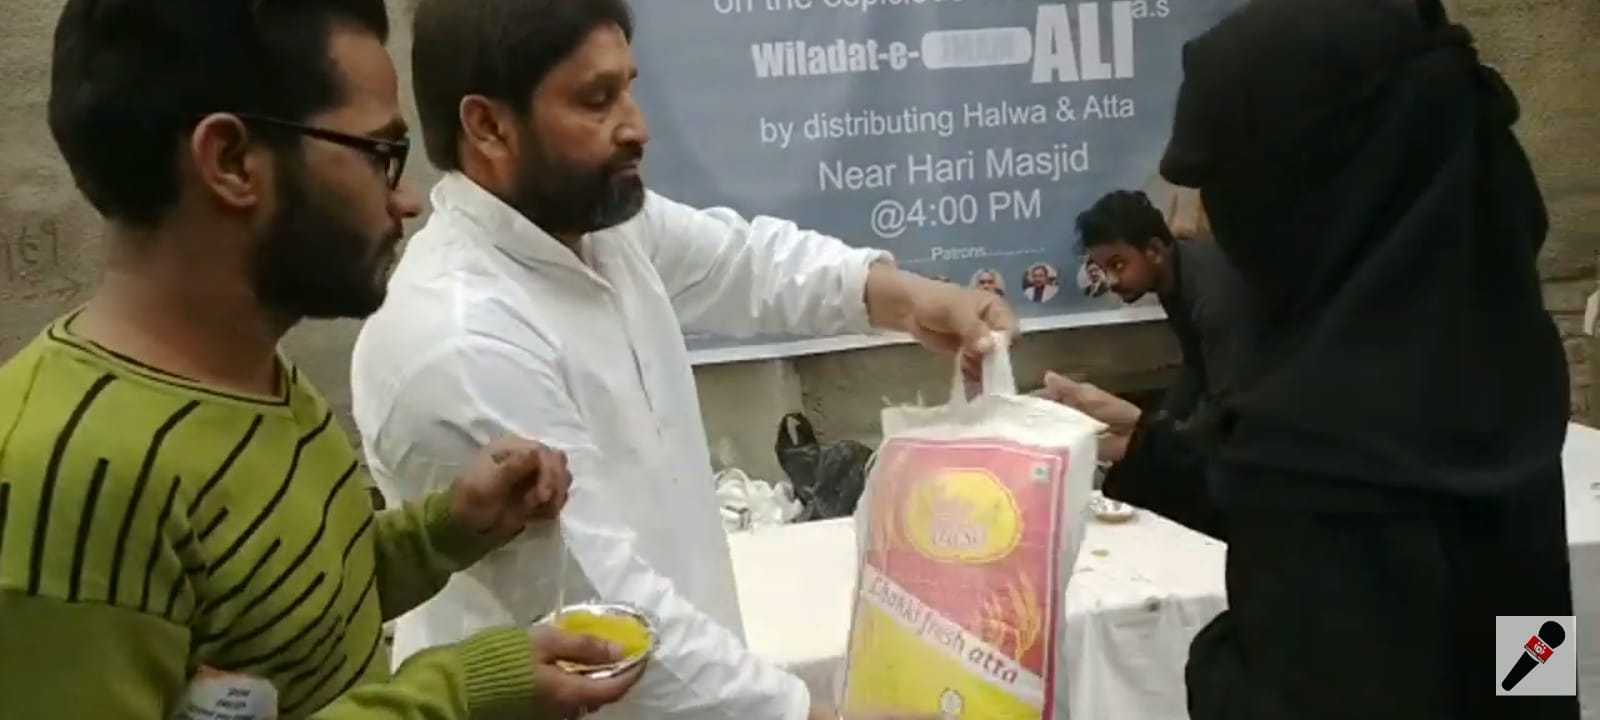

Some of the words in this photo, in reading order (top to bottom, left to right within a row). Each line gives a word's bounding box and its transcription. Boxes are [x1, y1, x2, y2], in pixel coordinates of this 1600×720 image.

[751, 38, 920, 78] Wiladat-e-
[1031, 1, 1135, 84] ALI
[760, 116, 794, 149] by
[804, 106, 953, 139] distributing
[964, 100, 1047, 128] Halwa
[1056, 97, 1075, 122] &
[1083, 95, 1135, 119] Atta
[819, 160, 896, 192] Near
[908, 151, 974, 184] Hari
[987, 142, 1089, 183] Masjid
[871, 195, 978, 238] @4:00
[989, 190, 1042, 223] PM
